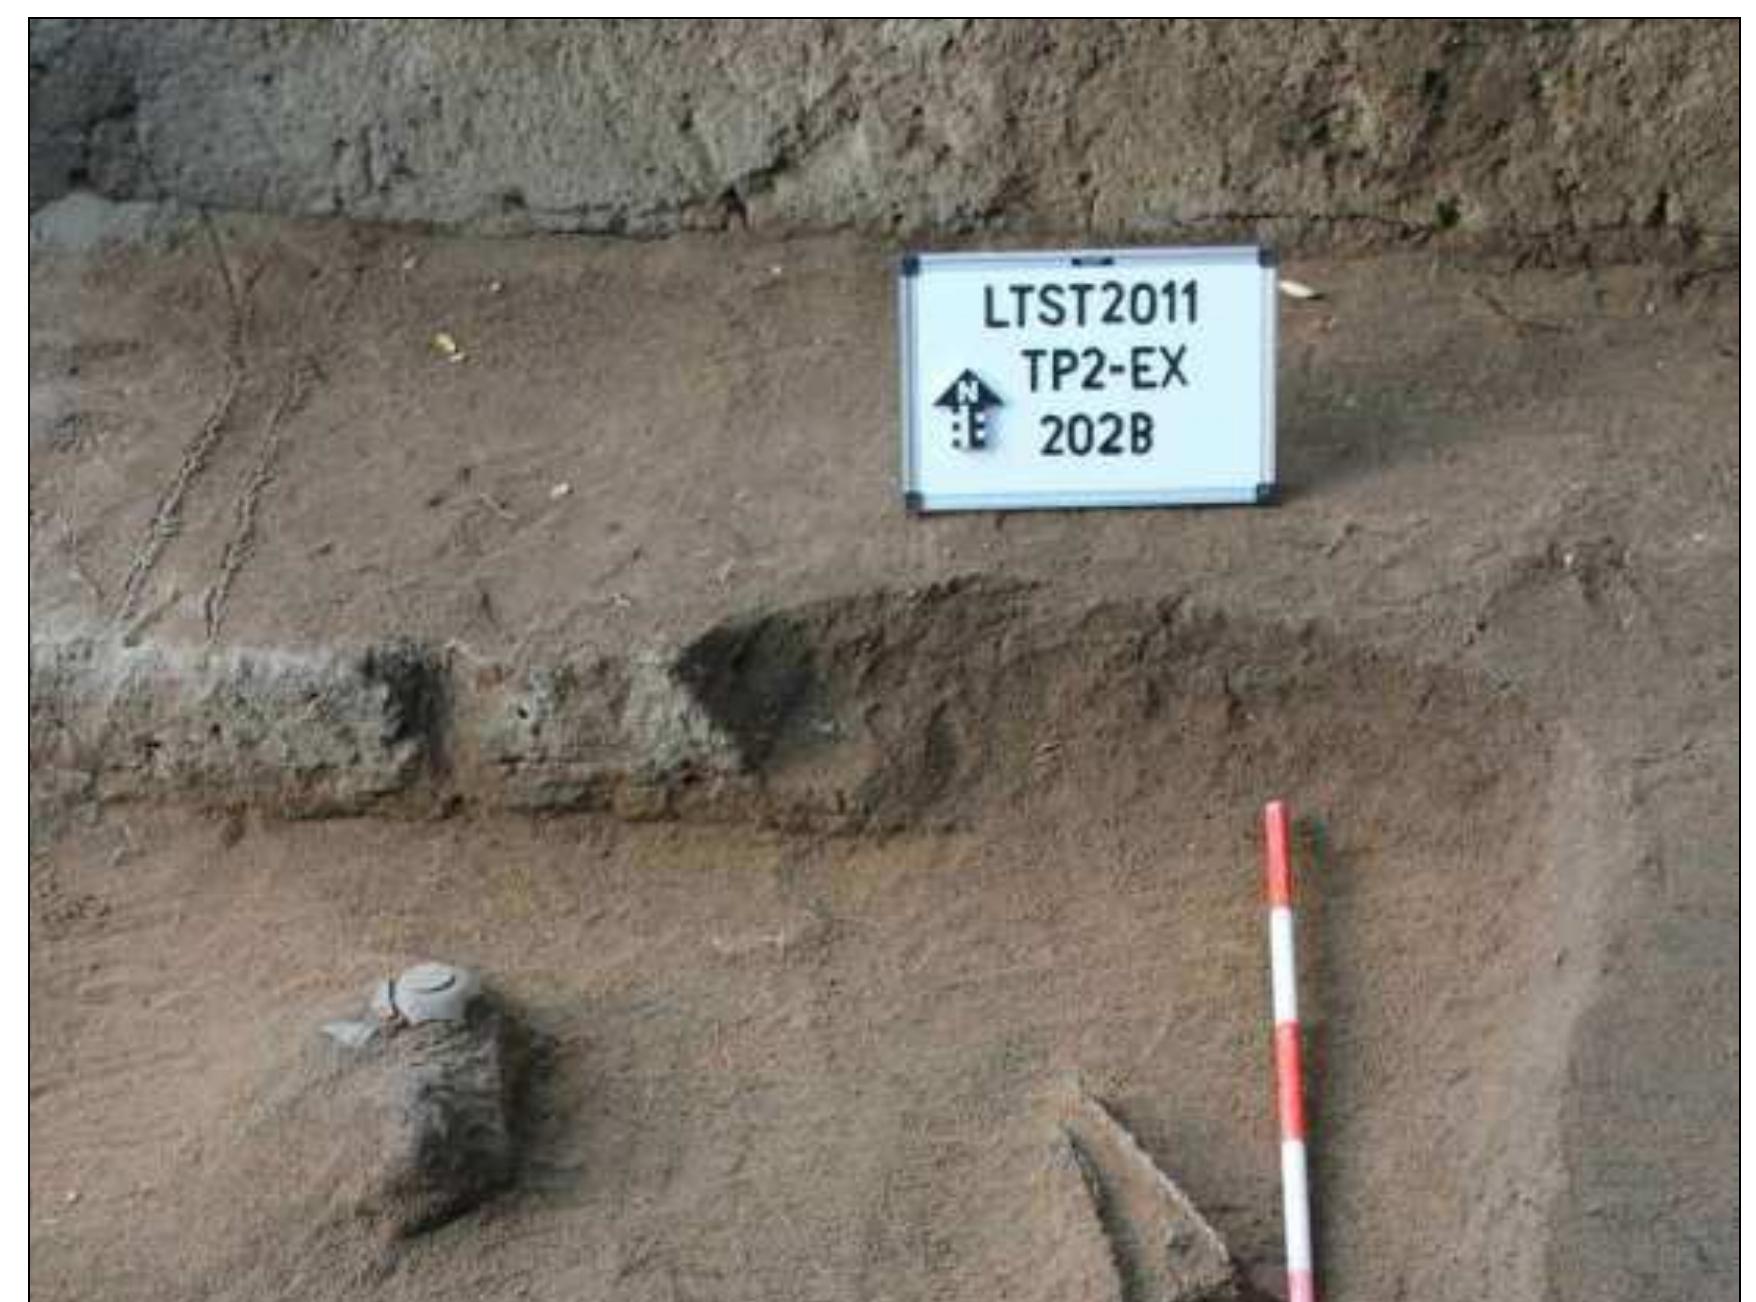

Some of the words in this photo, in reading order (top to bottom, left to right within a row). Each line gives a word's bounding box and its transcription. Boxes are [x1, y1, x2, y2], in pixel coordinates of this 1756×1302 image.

[984, 280, 1198, 329] LTST2011
[1022, 346, 1189, 392] TP2-EX
[1041, 412, 1155, 456] 202B
